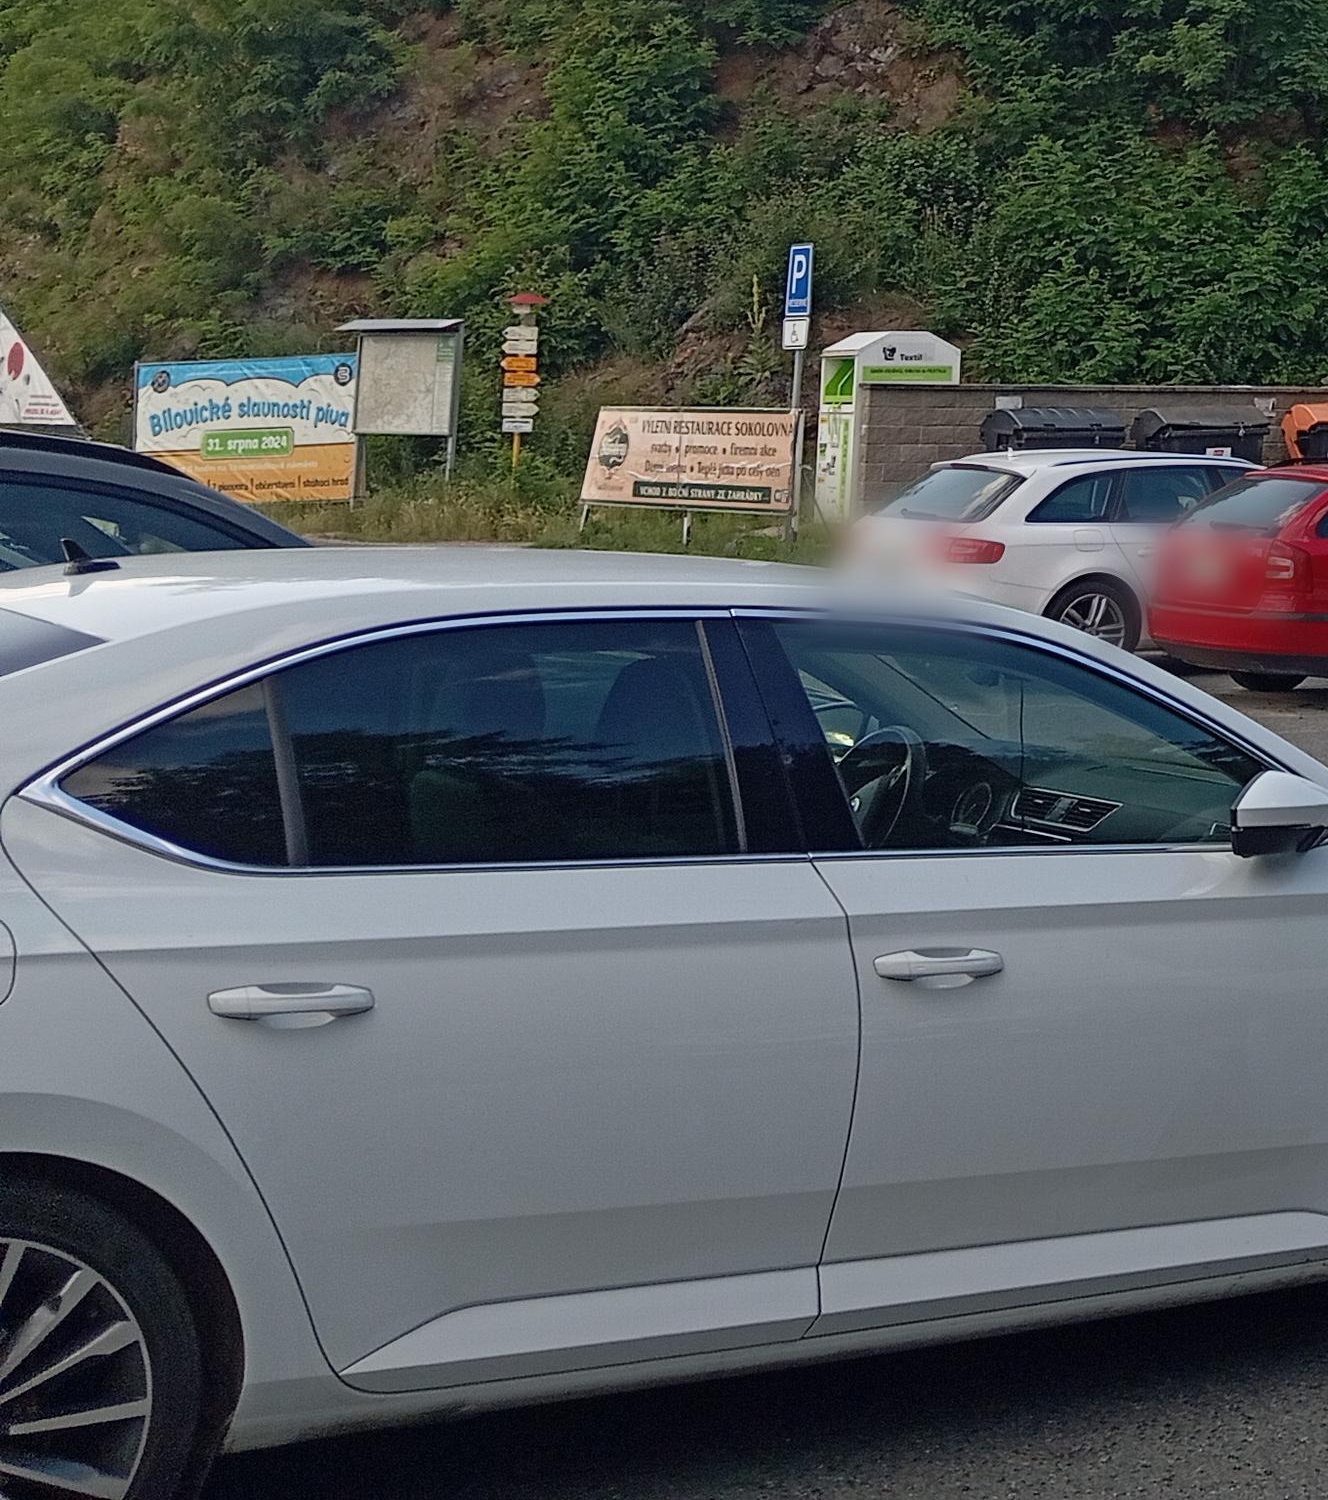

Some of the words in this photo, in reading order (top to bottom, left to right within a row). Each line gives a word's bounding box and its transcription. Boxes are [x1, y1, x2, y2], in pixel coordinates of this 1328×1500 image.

[791, 254, 807, 294] P
[149, 396, 232, 437] Bílovické
[236, 396, 312, 421] slavnosti
[313, 403, 350, 429] piva
[673, 420, 733, 436] RESTAURACE
[734, 421, 793, 437] SOKOLOVNA
[206, 438, 224, 451] 31.
[227, 439, 259, 454] srpna
[261, 435, 288, 449] 2024
[684, 444, 719, 457] promoce
